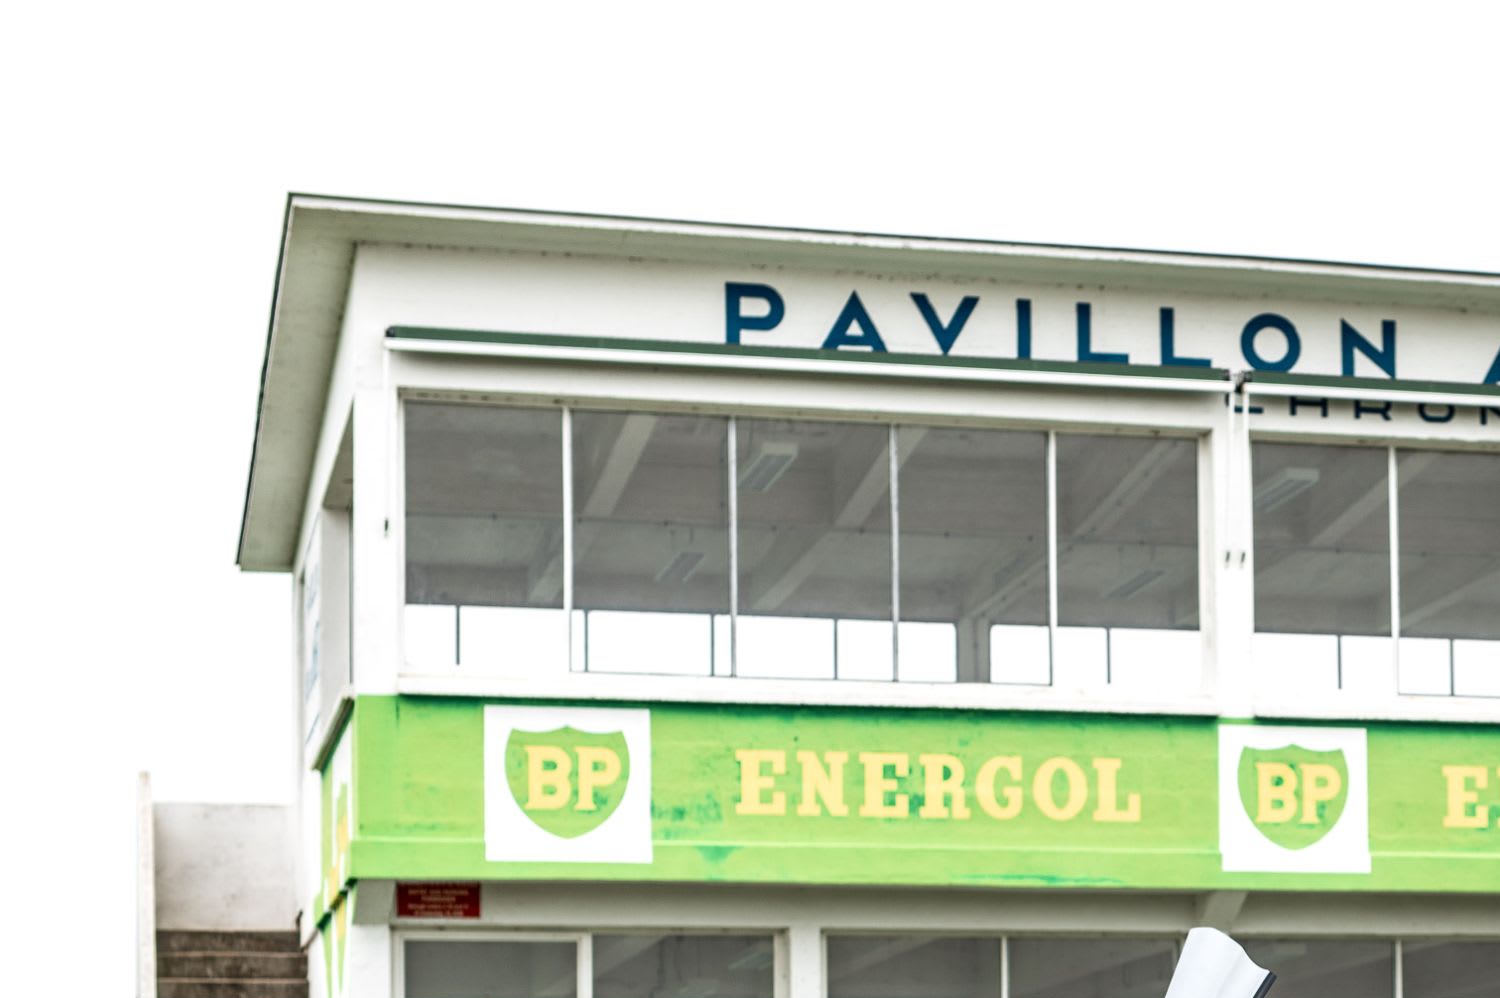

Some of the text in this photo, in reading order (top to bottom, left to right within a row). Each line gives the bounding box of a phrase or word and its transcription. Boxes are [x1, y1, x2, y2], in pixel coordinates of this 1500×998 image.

[725, 282, 1396, 379] PAVILLON
[524, 745, 622, 812] BP
[735, 749, 1141, 822] ENERGOL
[1256, 762, 1341, 825] BP
